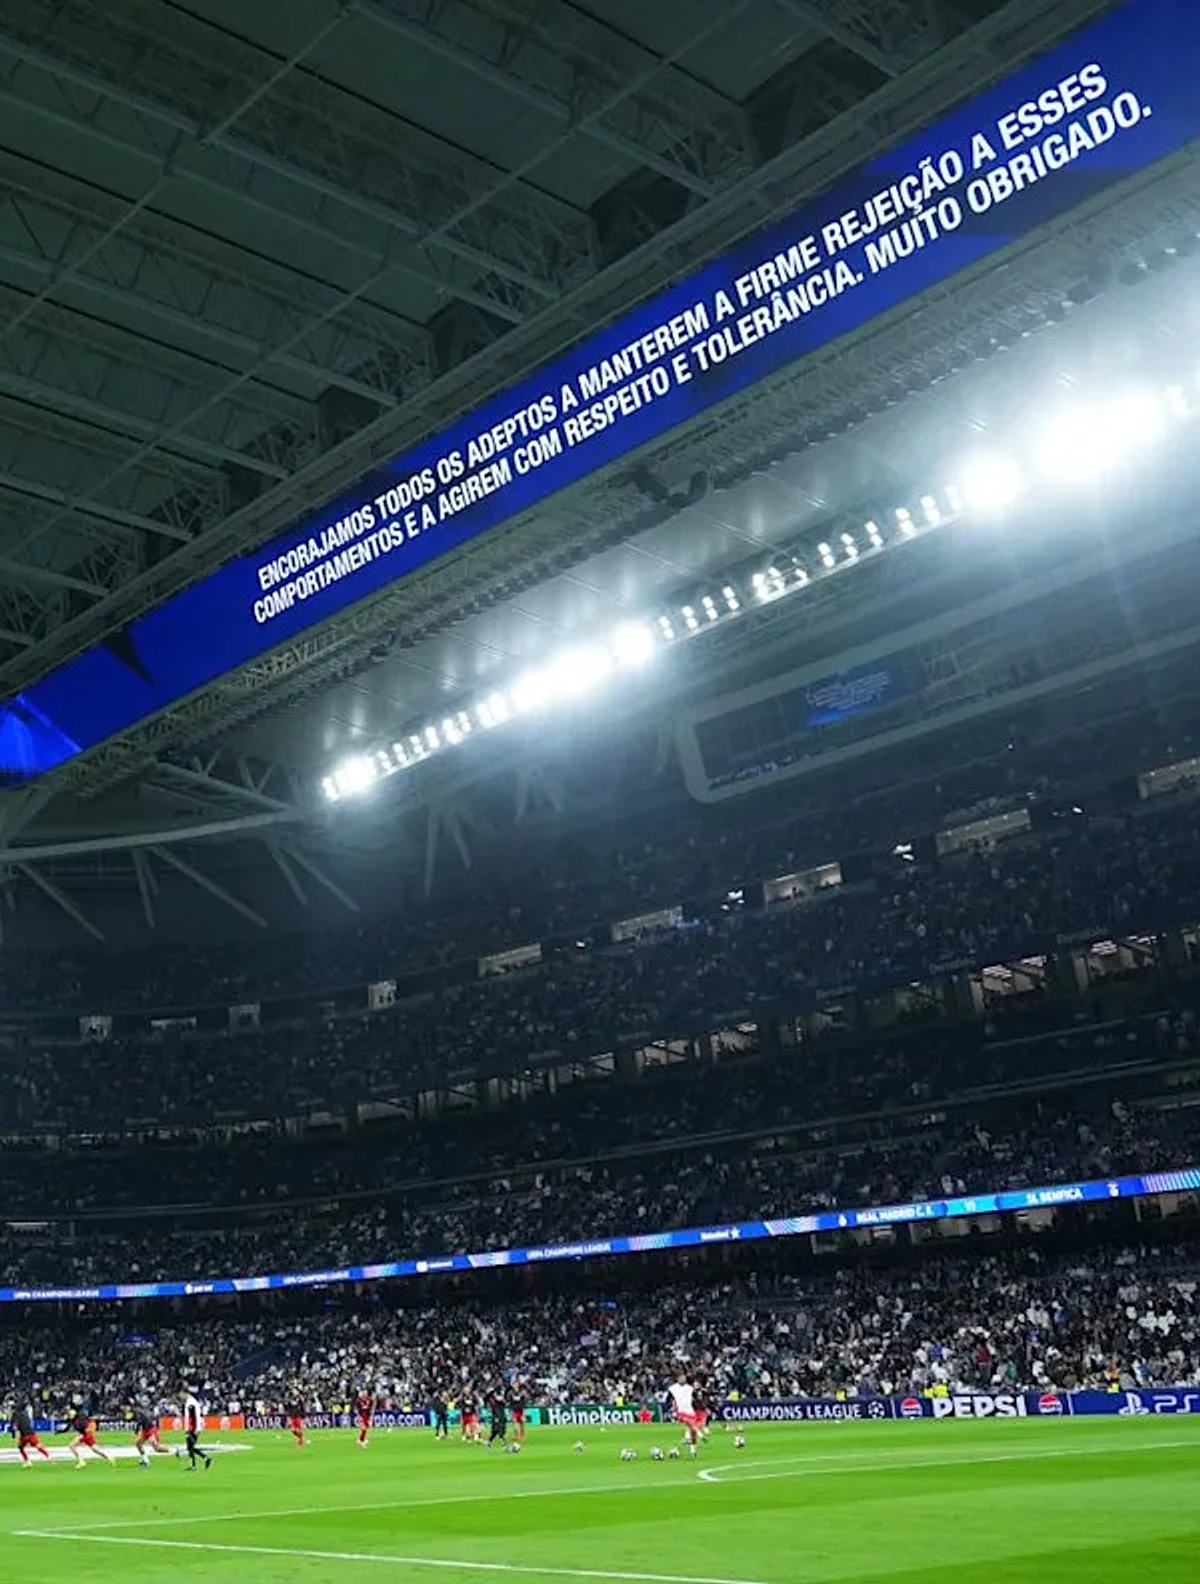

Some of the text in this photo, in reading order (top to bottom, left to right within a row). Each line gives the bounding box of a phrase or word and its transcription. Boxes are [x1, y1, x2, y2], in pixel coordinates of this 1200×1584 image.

[258, 63, 1107, 591] ENCORAJAMOS TODOS OS ADEPTOS A MANTEREM A FIRME REJEIÇÃO A ESSES
[253, 92, 1152, 623] COMPORTAMENTOS E A AGIREM COM RESPEITO E TOLERÂNCIA. MUITO OBRIGADO.
[548, 1406, 634, 1425] Heineken
[723, 1403, 862, 1420] CHAMPIONS LEAGUE
[932, 1393, 1027, 1418] PEPSI
[354, 1412, 425, 1427] cpto.com
